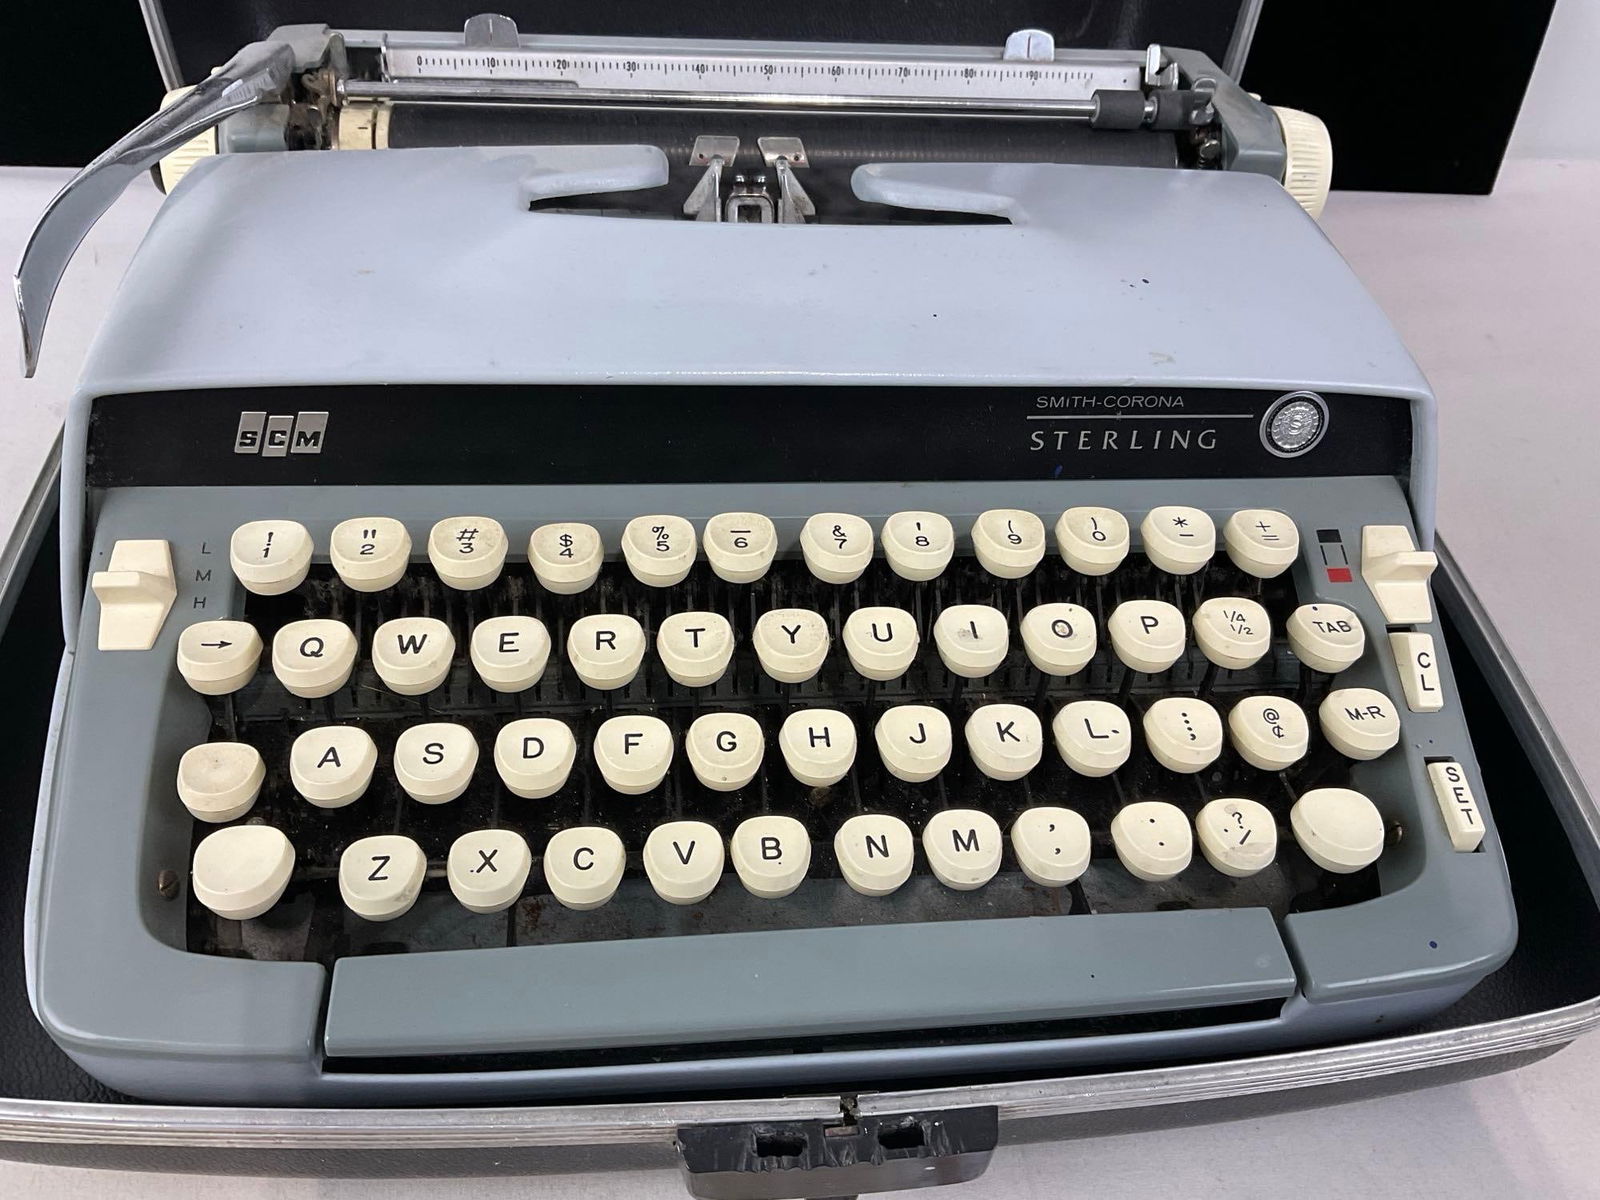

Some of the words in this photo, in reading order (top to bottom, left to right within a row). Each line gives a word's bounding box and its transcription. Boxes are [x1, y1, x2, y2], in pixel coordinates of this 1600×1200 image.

[416, 55, 422, 67] 0
[486, 57, 496, 69] 10
[556, 58, 567, 70] 20
[626, 60, 636, 72] 30
[695, 62, 705, 74] 40
[763, 64, 774, 75] 50
[831, 65, 841, 77] 60
[898, 66, 908, 78] 70
[965, 68, 974, 79] 80
[1029, 69, 1039, 81] 90
[1036, 395, 1184, 408] SMITH-CORONA
[1030, 429, 1217, 451] STERLING
[456, 528, 480, 542] #
[559, 533, 574, 548] $
[651, 525, 670, 541] %
[832, 524, 847, 538] &
[915, 535, 930, 547] 8
[1007, 533, 1023, 545] 9
[201, 542, 212, 555] L
[359, 543, 376, 556] 2
[458, 542, 475, 554] 3
[559, 547, 574, 559] 4
[656, 540, 670, 552] 5
[733, 536, 749, 549] 6
[834, 538, 848, 550] 7
[195, 569, 212, 582] M
[193, 597, 207, 609] H
[781, 624, 802, 645] Y
[871, 622, 893, 643] U
[1051, 619, 1074, 639] O
[1140, 615, 1159, 635] P
[1312, 620, 1352, 633] TAB
[299, 636, 324, 658] Q
[397, 633, 428, 655] W
[498, 632, 520, 653] E
[595, 630, 617, 651] R
[684, 627, 706, 648] T
[1262, 707, 1280, 725] @
[1344, 705, 1386, 721] M-R
[716, 730, 738, 753] G
[808, 726, 831, 748] H
[909, 722, 927, 744] J
[995, 721, 1021, 743] K
[422, 742, 445, 765] S
[522, 737, 545, 759] D
[624, 733, 644, 755] F
[316, 746, 342, 769] A
[1445, 766, 1474, 825] SET
[761, 836, 783, 861] B
[865, 834, 890, 859] N
[952, 828, 980, 853] M
[475, 849, 498, 874] X
[573, 847, 595, 871] C
[672, 840, 696, 865] V
[367, 855, 391, 882] Z
